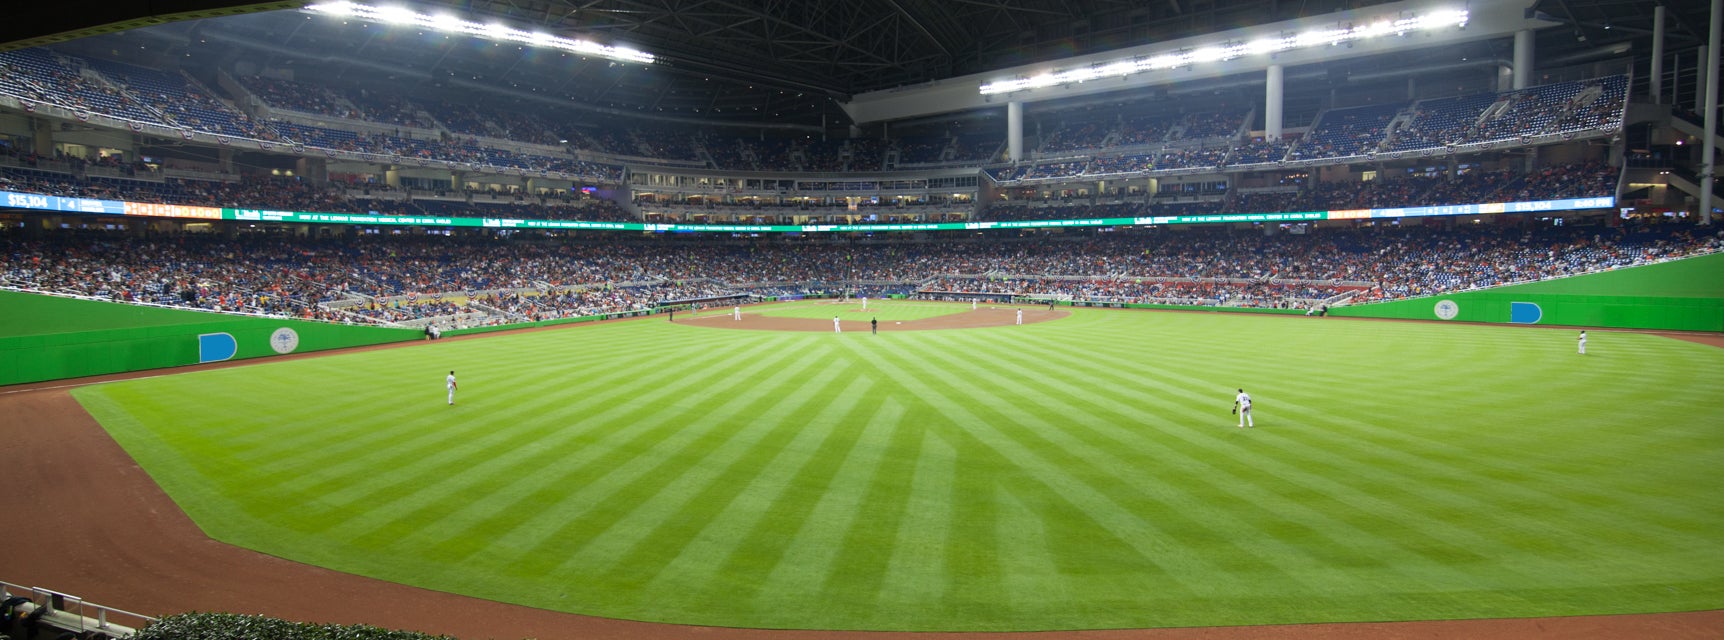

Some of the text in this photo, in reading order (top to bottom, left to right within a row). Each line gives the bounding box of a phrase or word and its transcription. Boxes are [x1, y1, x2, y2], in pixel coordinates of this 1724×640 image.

[8, 194, 48, 208] $15,104
[1515, 201, 1552, 211] $15,104
[1596, 198, 1611, 207] PM
